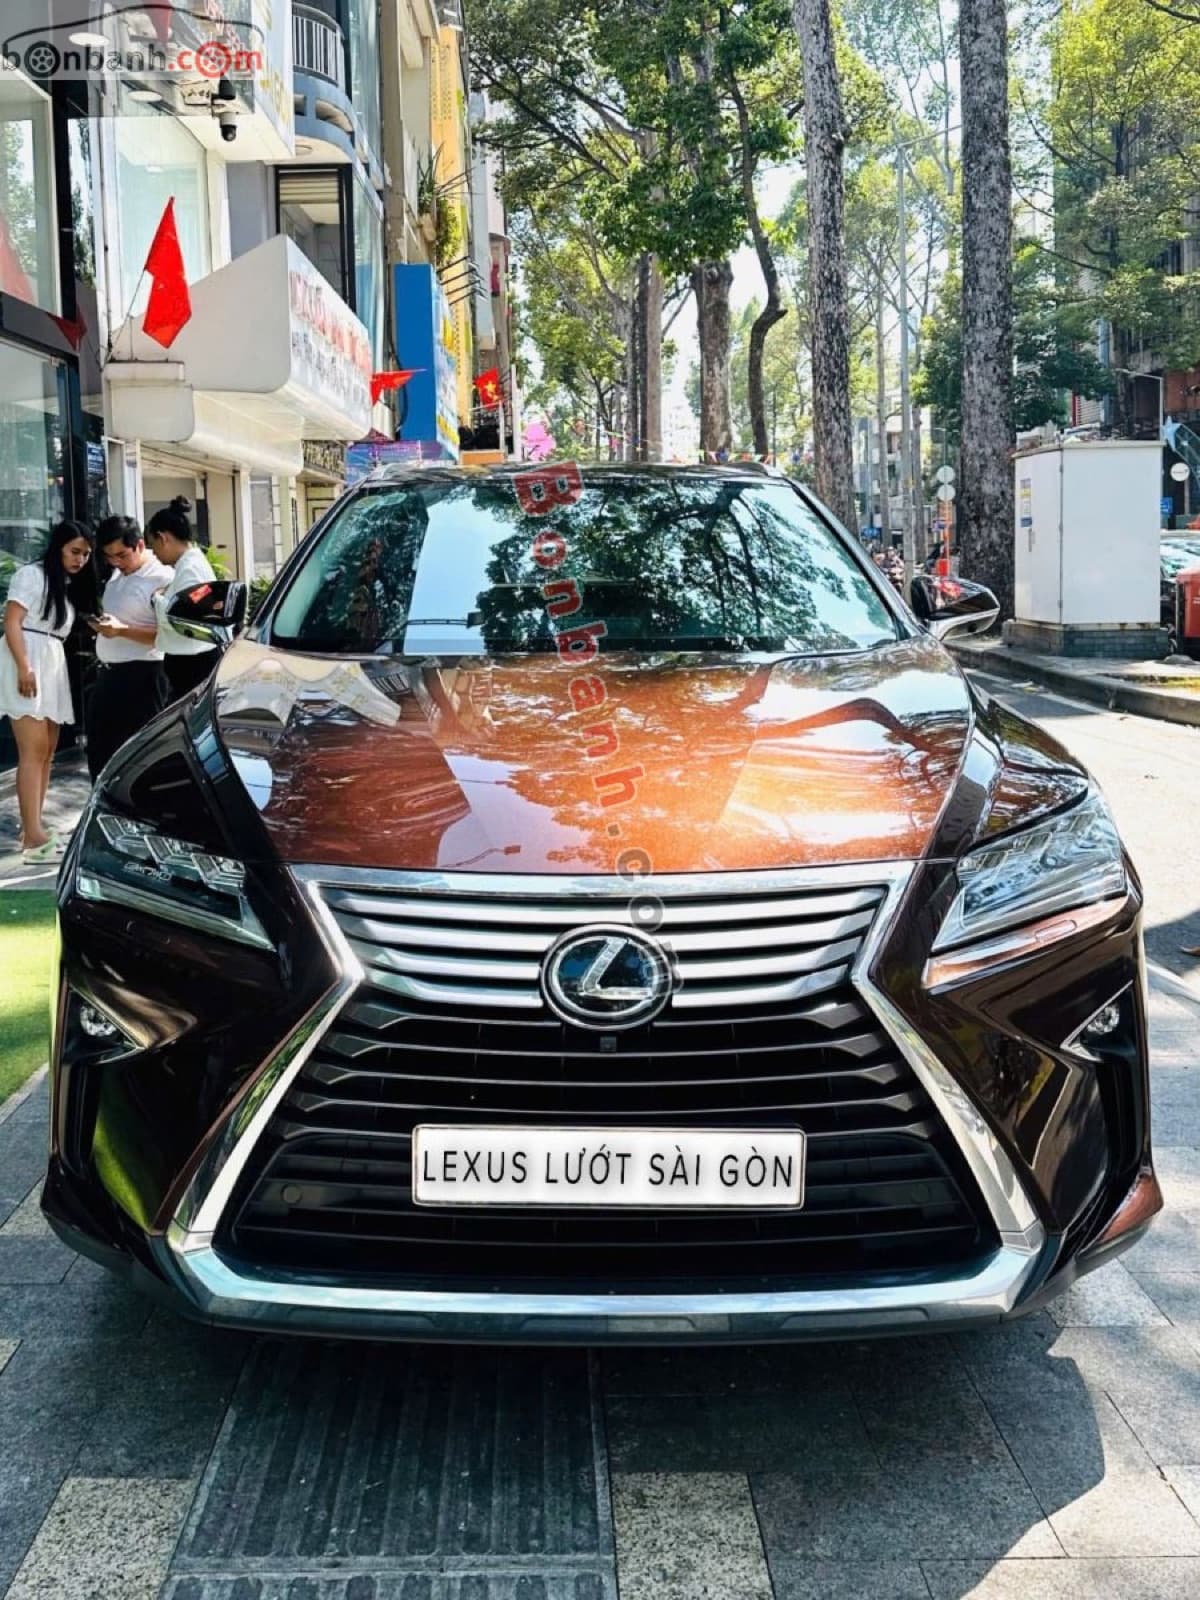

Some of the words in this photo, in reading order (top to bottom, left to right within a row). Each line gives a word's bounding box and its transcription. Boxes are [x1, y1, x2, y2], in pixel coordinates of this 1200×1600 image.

[423, 1150, 528, 1184] LEXUS
[545, 1144, 632, 1186] LƯỚT
[648, 1145, 702, 1187] SÀI
[719, 1146, 793, 1188] GÒN
